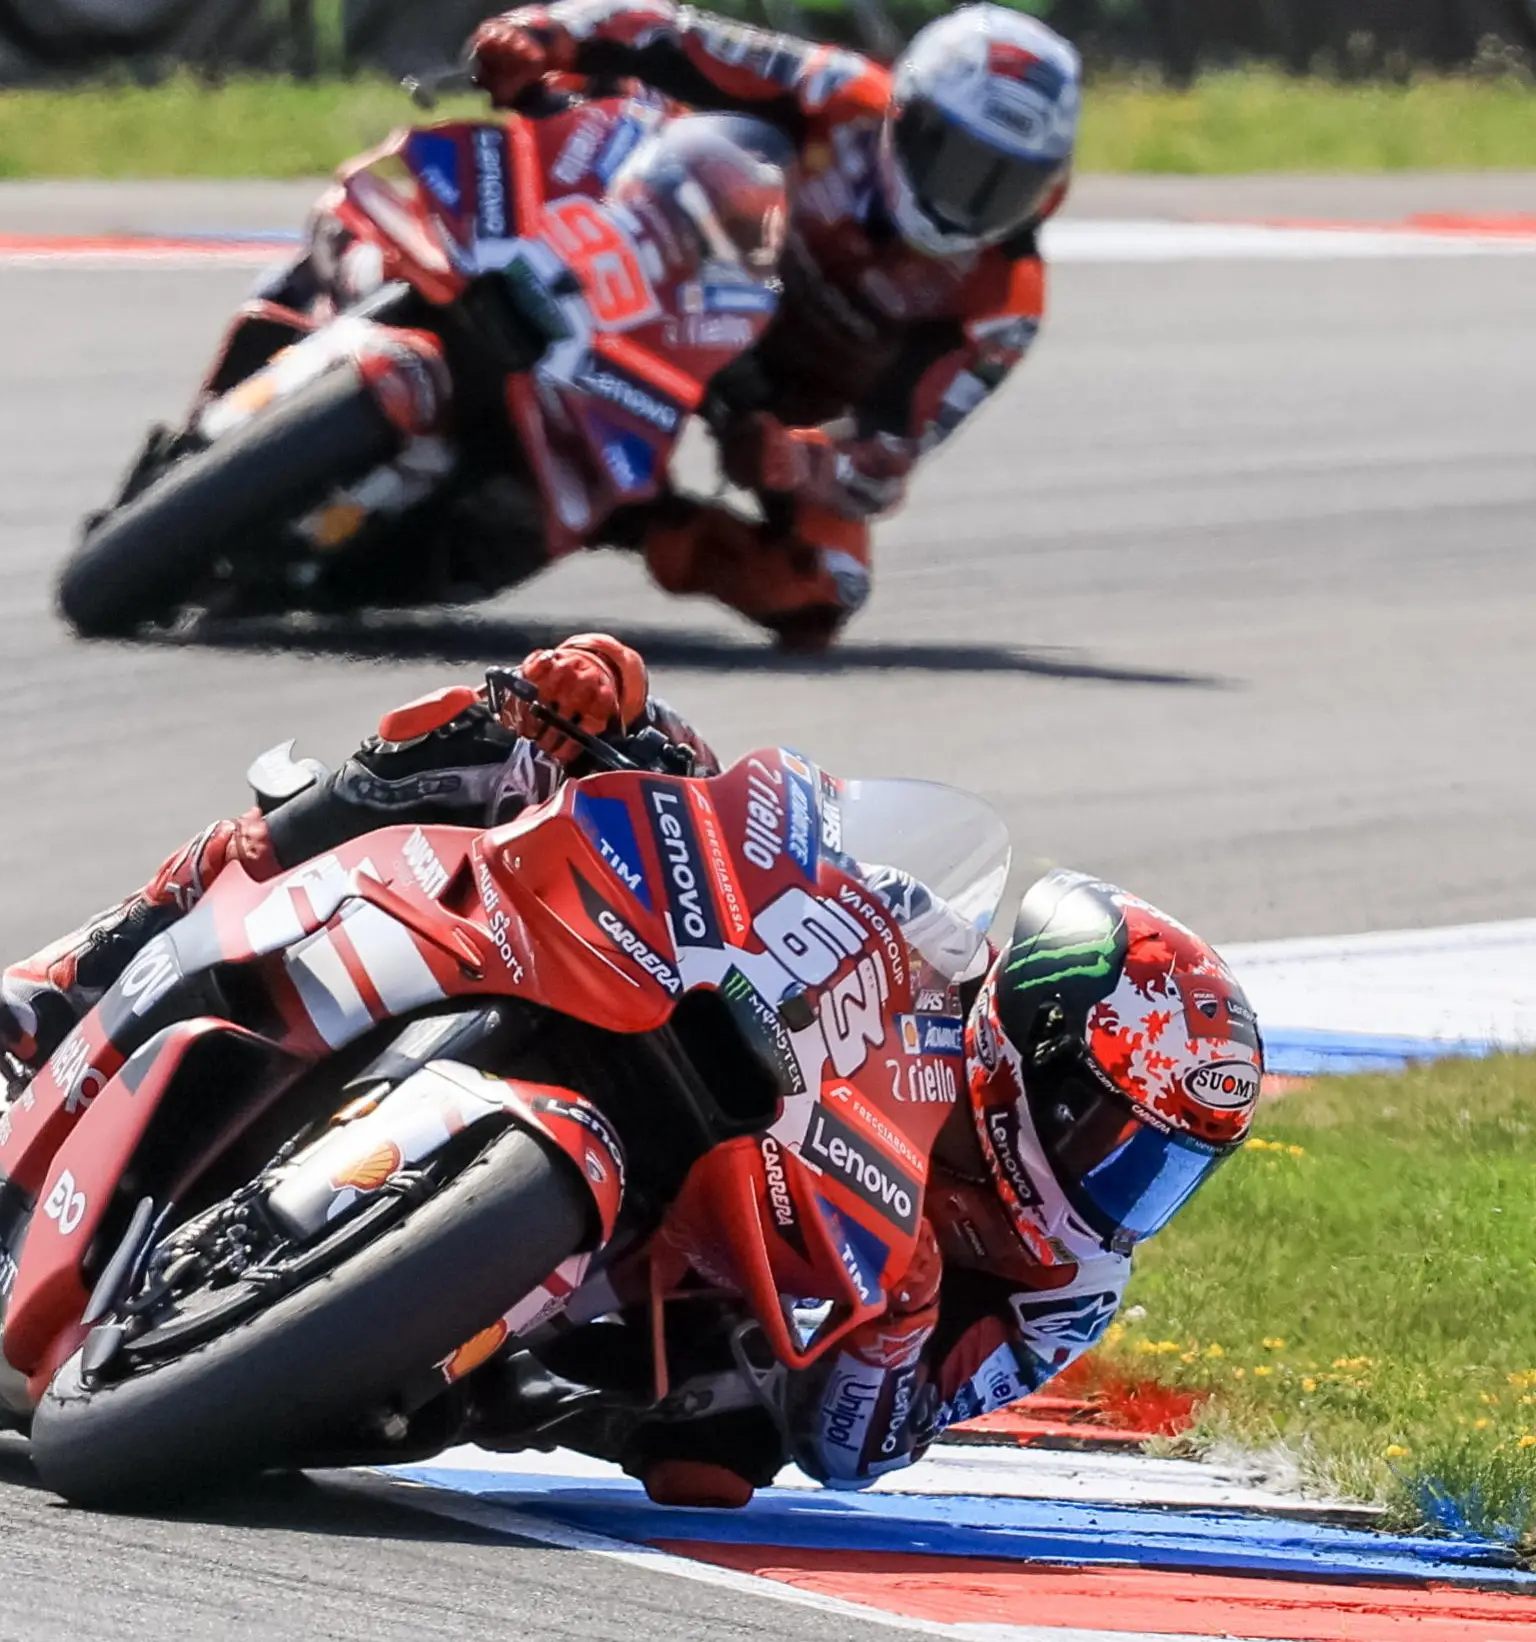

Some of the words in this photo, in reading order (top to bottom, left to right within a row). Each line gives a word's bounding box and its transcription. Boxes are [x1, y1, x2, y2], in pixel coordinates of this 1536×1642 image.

[480, 130, 505, 232] Lenovo
[545, 198, 658, 330] 93
[401, 826, 450, 900] DUCATI
[599, 838, 642, 890] TIM
[652, 790, 707, 939] Lenovo
[742, 773, 785, 871] riello
[479, 863, 501, 913] Audi
[703, 820, 745, 933] FRECCIAROSSA
[489, 910, 525, 985] Sport
[596, 909, 682, 995] CARRERA
[839, 884, 905, 986] VARGROUP
[752, 886, 890, 1079] 63
[748, 994, 803, 1093] MONSTER
[907, 1058, 957, 1103] riello
[851, 1101, 925, 1173] FRECCIAROSSA
[990, 1111, 1032, 1200] Lenovo
[1131, 1104, 1171, 1136] CARRERA
[761, 1137, 795, 1226] CARRERA
[812, 1116, 913, 1218] Lenovo
[822, 1378, 878, 1452] Unipol
[880, 1370, 915, 1453] Lenovo
